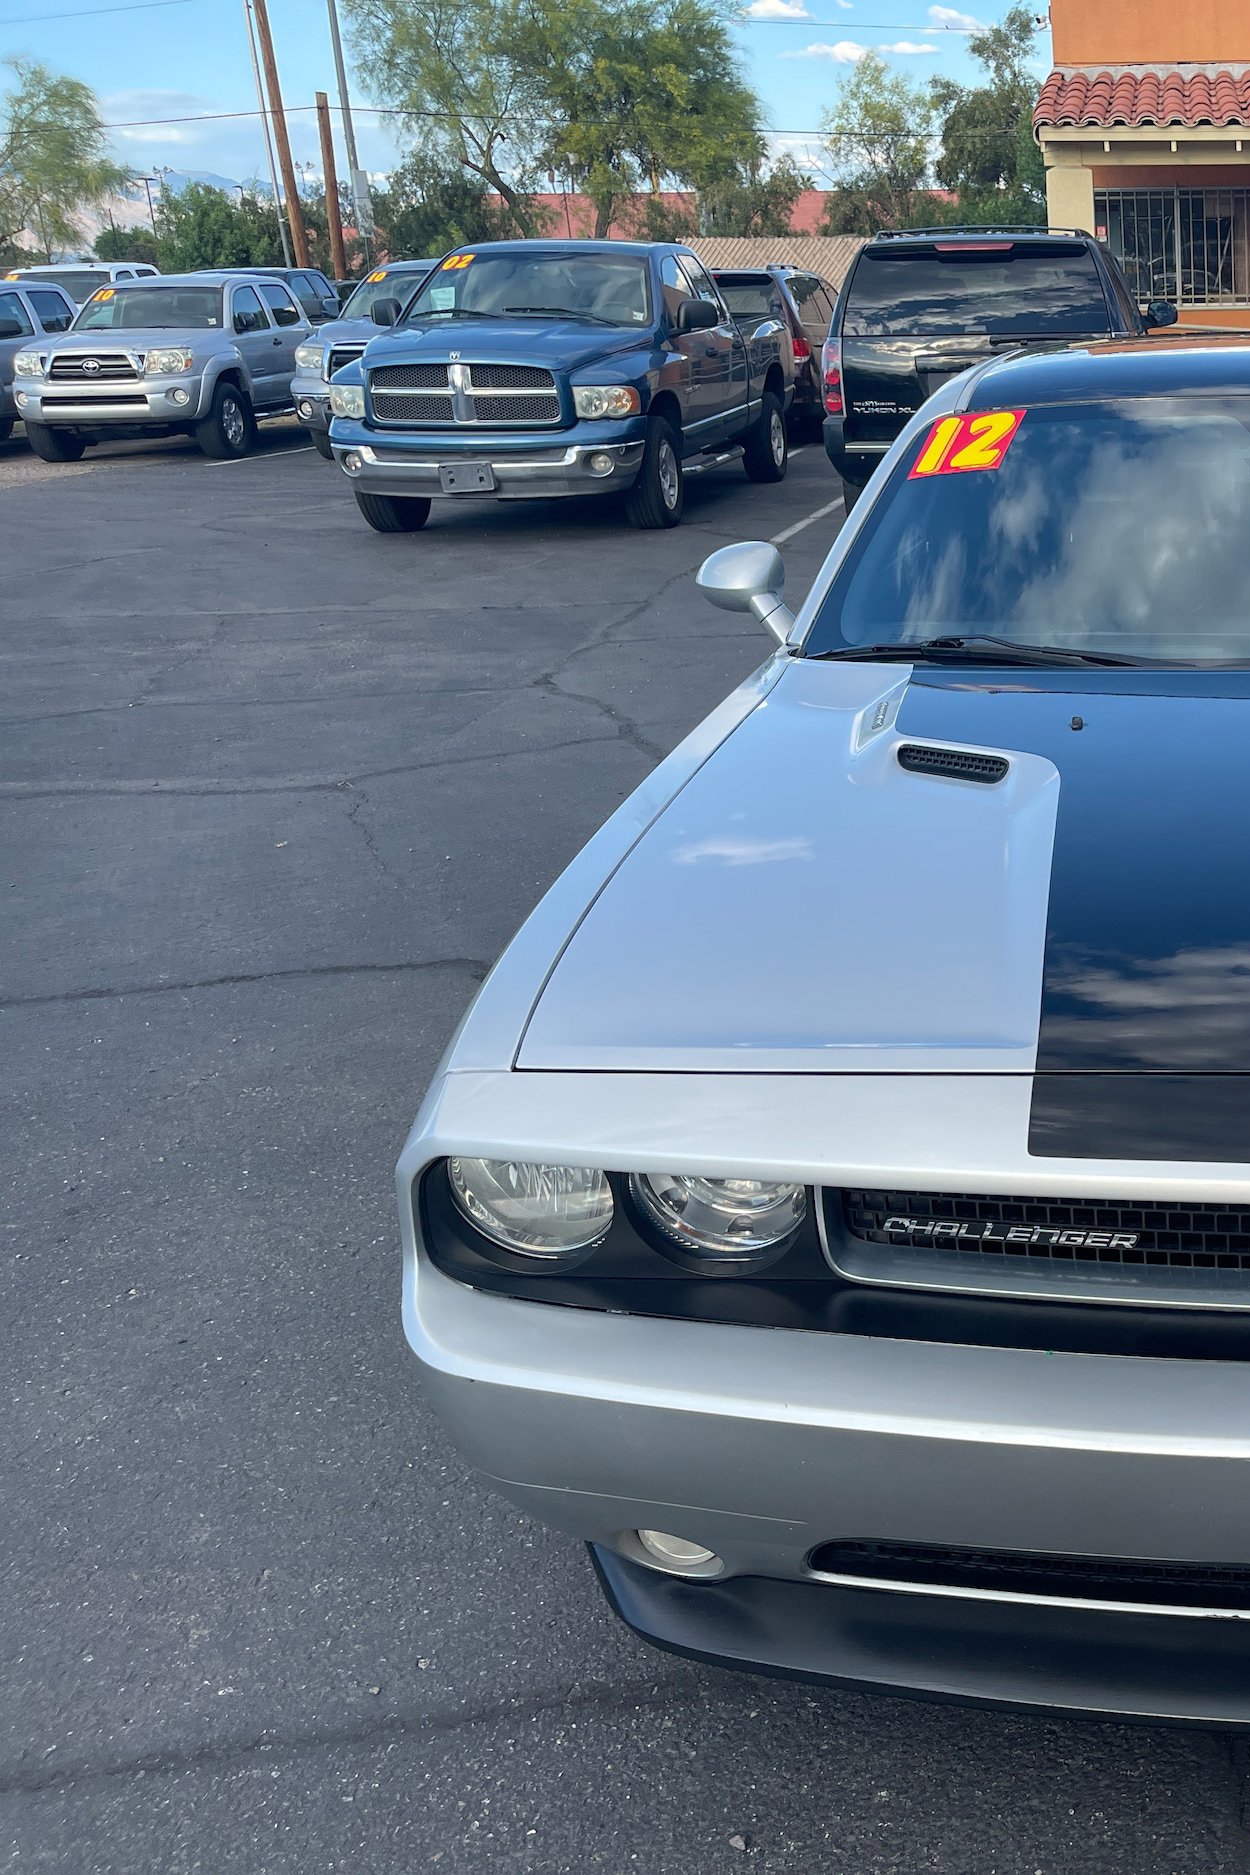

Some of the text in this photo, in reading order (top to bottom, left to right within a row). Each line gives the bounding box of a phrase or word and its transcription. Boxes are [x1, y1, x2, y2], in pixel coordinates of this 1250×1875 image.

[441, 254, 477, 271] 02
[366, 271, 388, 283] 10
[94, 289, 115, 302] 10
[915, 411, 1017, 474] 12
[882, 1216, 1139, 1249] CHALLENGER
